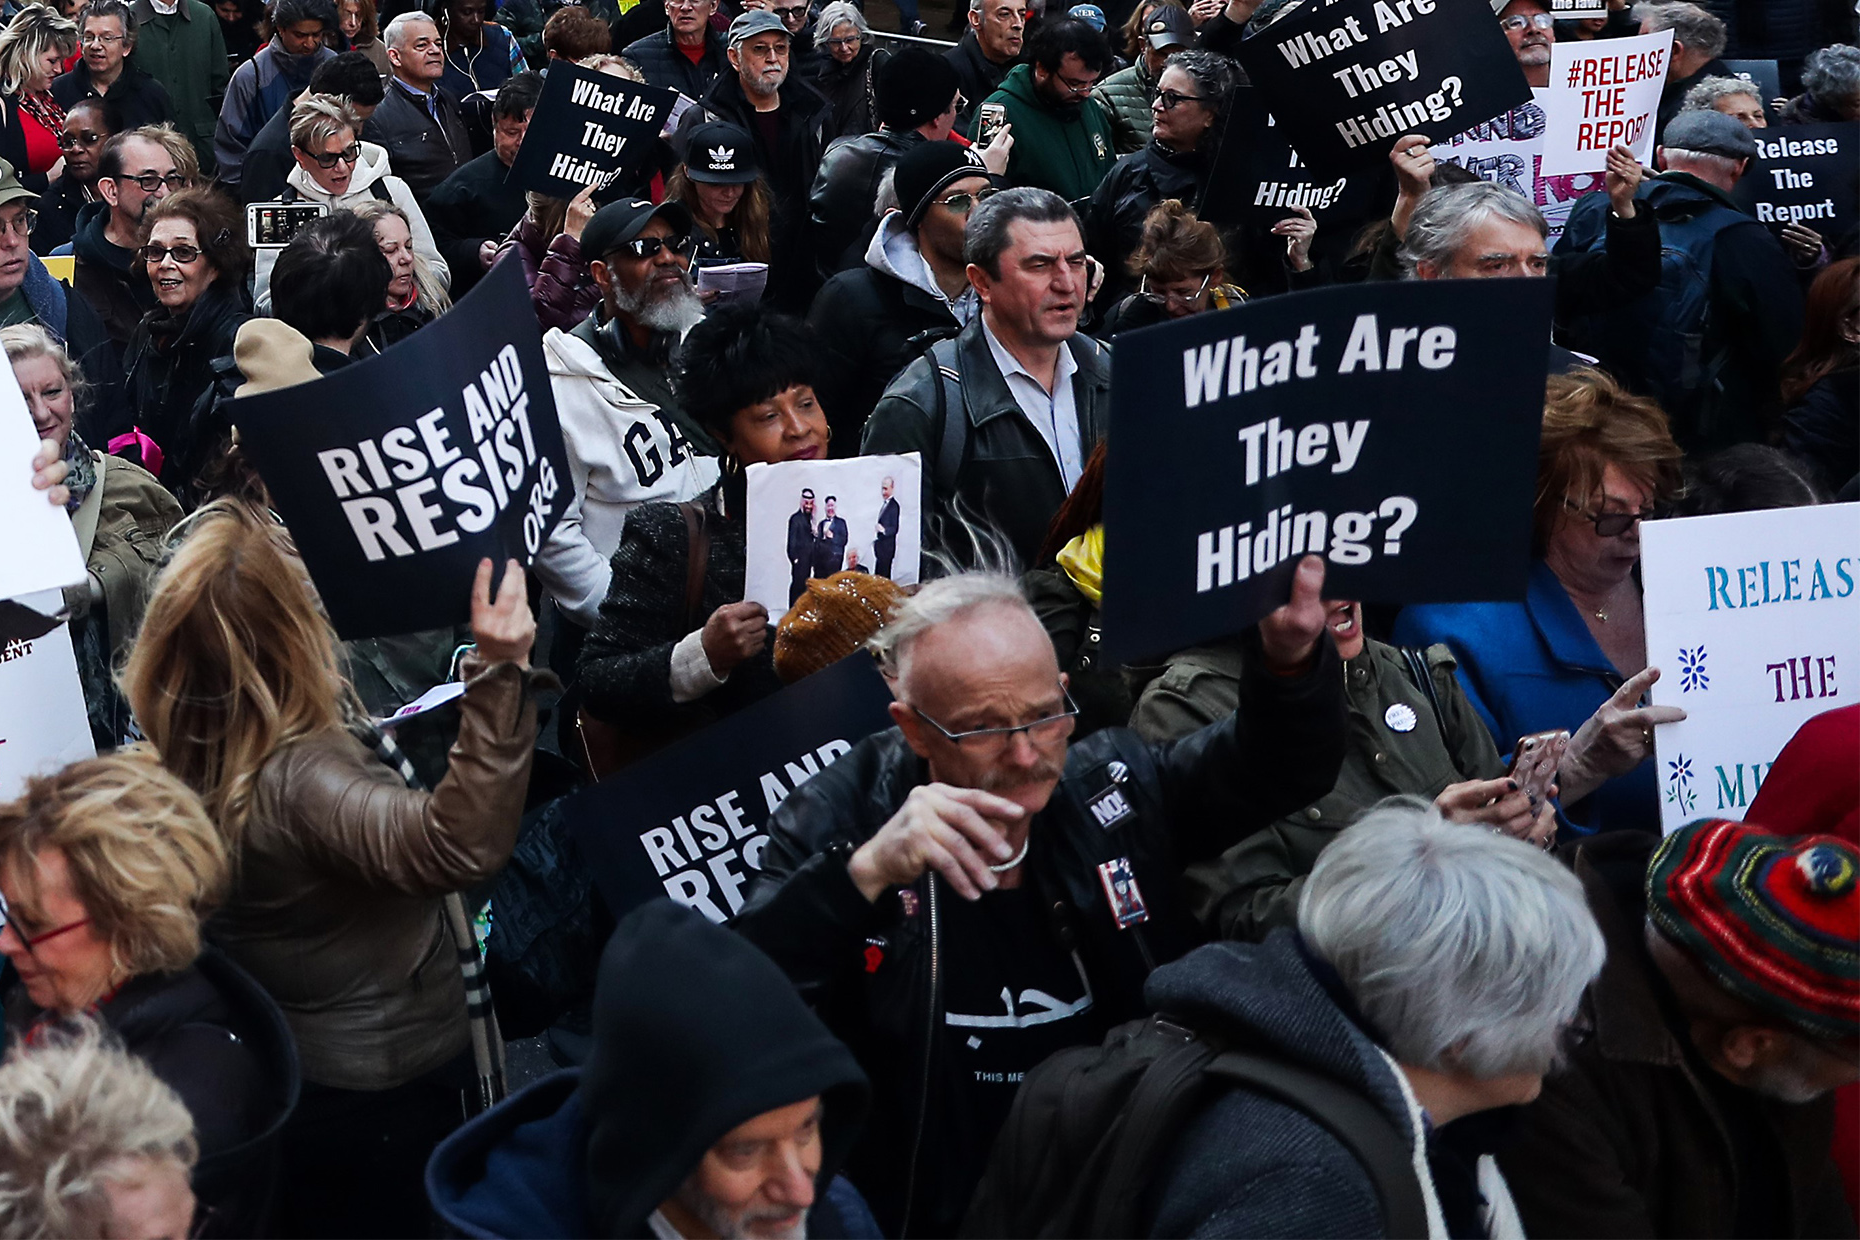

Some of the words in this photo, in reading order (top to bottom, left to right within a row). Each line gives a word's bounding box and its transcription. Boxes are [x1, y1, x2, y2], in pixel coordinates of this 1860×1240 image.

[1277, 16, 1368, 69] What
[1332, 47, 1420, 101] They
[1567, 47, 1665, 90] #RELEASE
[570, 78, 619, 116] What
[623, 90, 656, 123] Are
[1336, 75, 1465, 148] Hiding?
[1582, 87, 1626, 119] THE
[581, 120, 627, 158] They
[1575, 111, 1649, 152] REPORT
[548, 153, 622, 192] Hiding?
[708, 162, 735, 170] adidas
[1770, 168, 1814, 190] The
[1253, 177, 1347, 209] Hiding?
[1756, 199, 1836, 225] Report
[1182, 324, 1321, 408] What
[1338, 312, 1457, 374] Are
[317, 408, 462, 499] RISE
[462, 342, 525, 445] AND
[341, 391, 538, 562] RESIST
[1238, 419, 1371, 487] They
[522, 458, 559, 566] .ORG
[1195, 494, 1419, 594] Hiding?
[1705, 555, 1860, 611] RELEAS
[1766, 654, 1840, 703] THE
[1090, 791, 1130, 825] NO!
